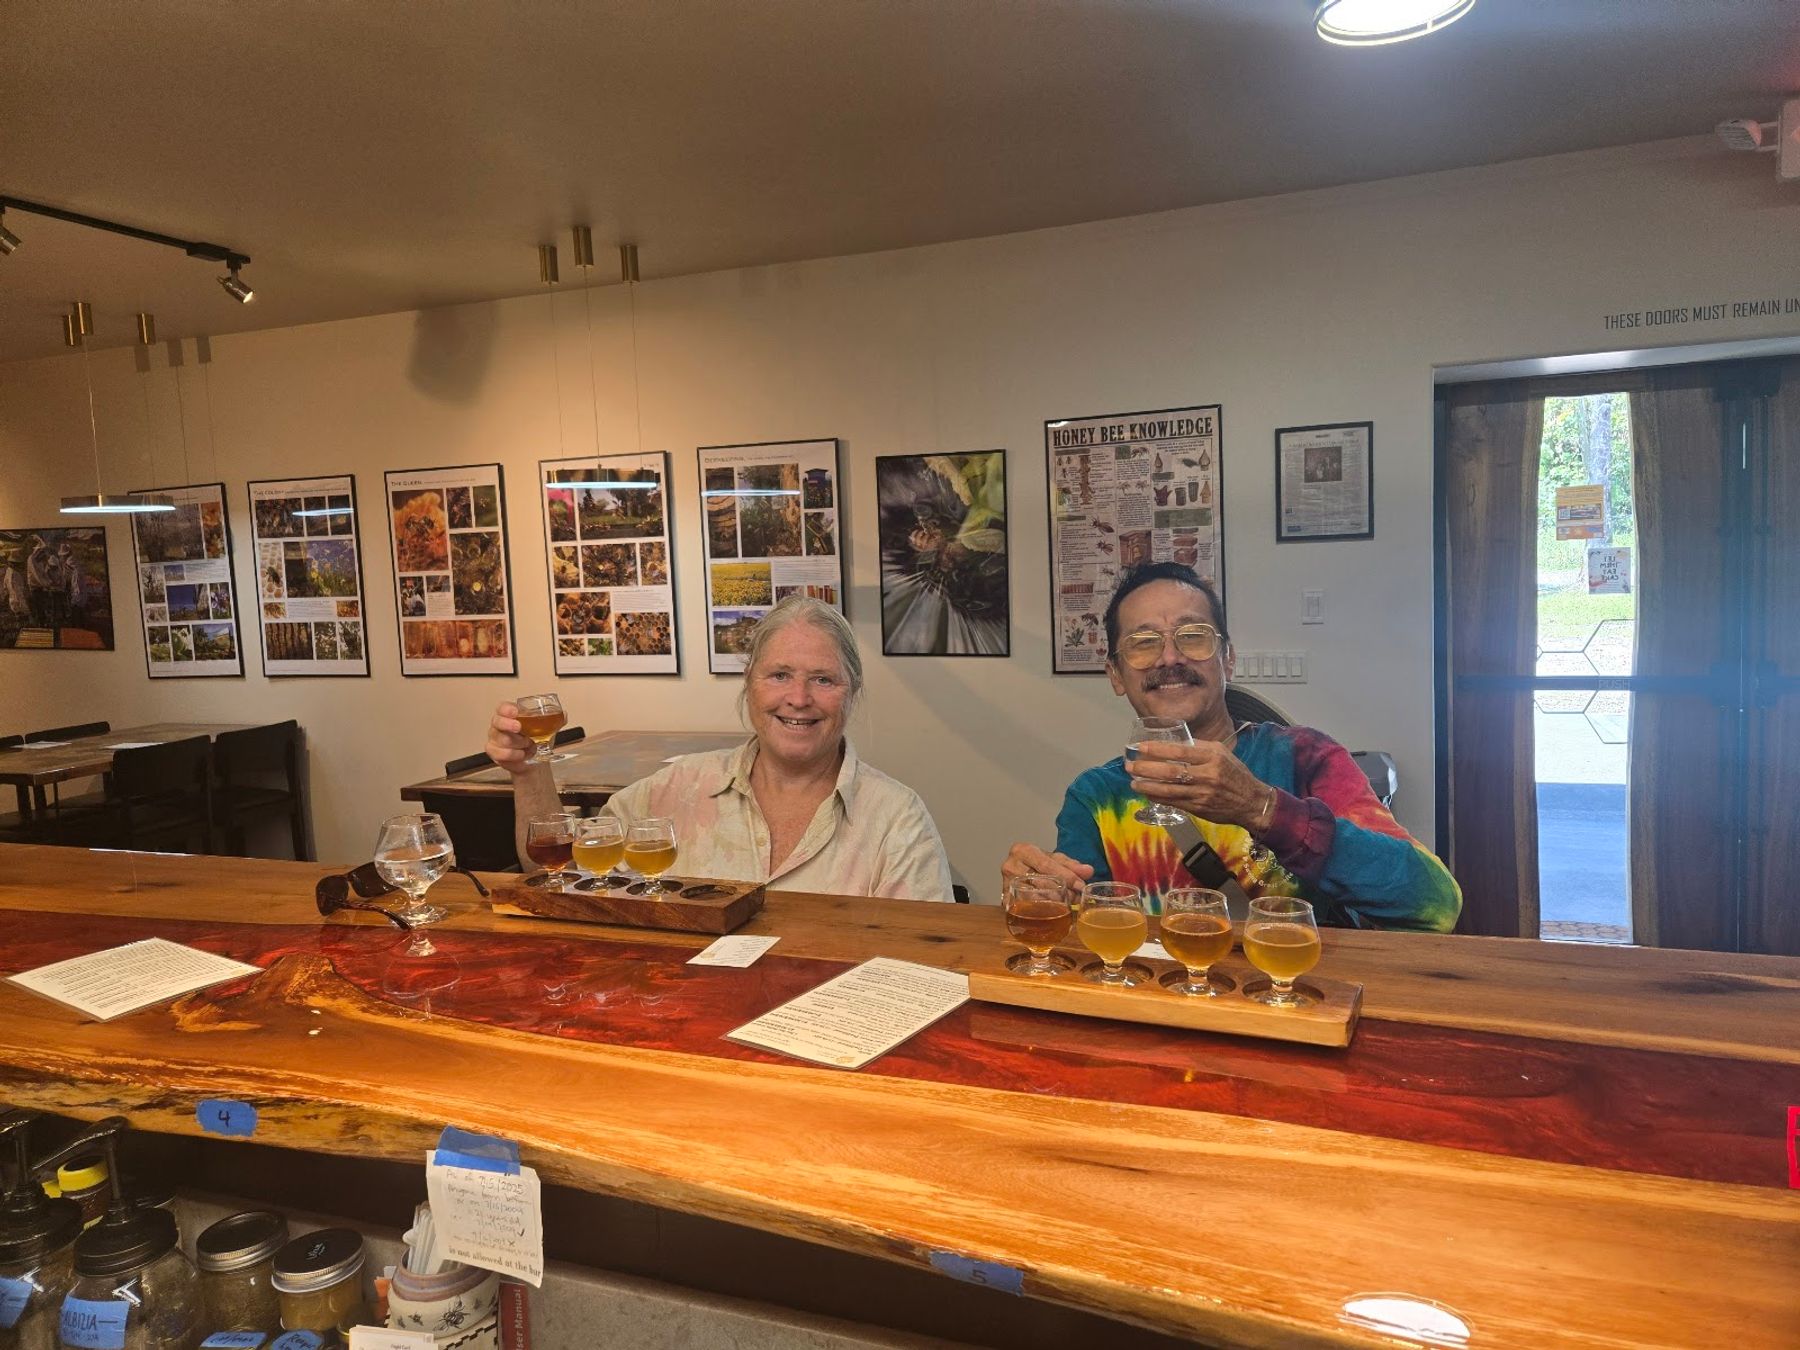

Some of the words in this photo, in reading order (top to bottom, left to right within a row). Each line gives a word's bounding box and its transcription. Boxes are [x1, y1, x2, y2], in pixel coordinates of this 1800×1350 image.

[1603, 312, 1641, 330] THESE
[1645, 308, 1688, 326] DOORS
[1692, 303, 1728, 321] MUST
[1733, 299, 1781, 318] REMAIN
[1052, 427, 1096, 447] HONEY
[1100, 424, 1126, 443] BEE
[1129, 416, 1213, 440] KNOWLEDGE
[218, 1110, 231, 1128] 4
[472, 1251, 503, 1266] allowed
[505, 1259, 513, 1269] at
[514, 1260, 527, 1272] the
[513, 1288, 523, 1329] Manual
